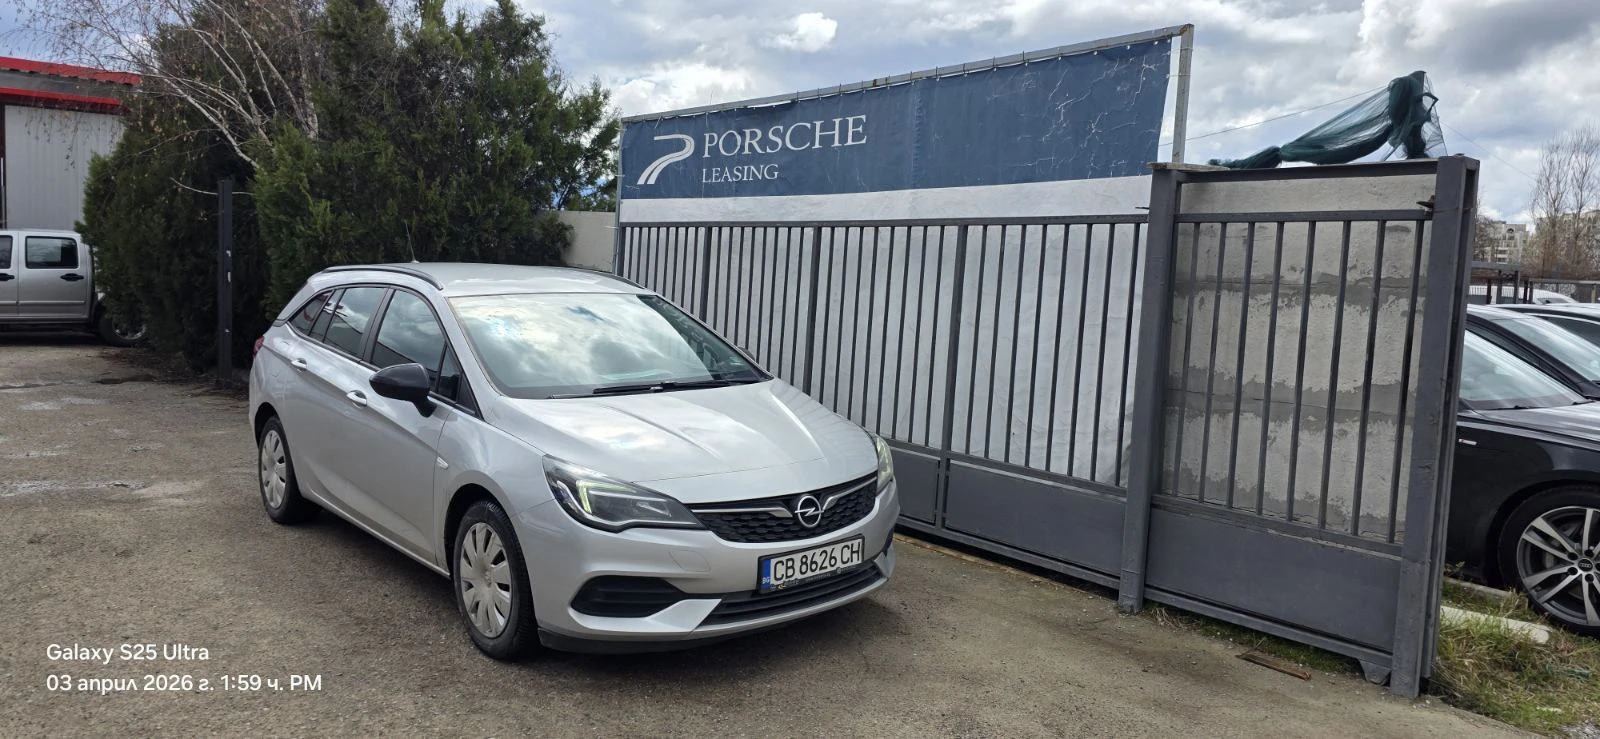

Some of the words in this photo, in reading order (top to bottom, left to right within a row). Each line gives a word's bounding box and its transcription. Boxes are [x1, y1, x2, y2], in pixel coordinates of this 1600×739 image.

[702, 114, 868, 158] PORSCHE
[702, 164, 779, 183] LEASING
[773, 558, 796, 582] CB
[799, 547, 838, 576] 8626
[840, 541, 861, 565] CH
